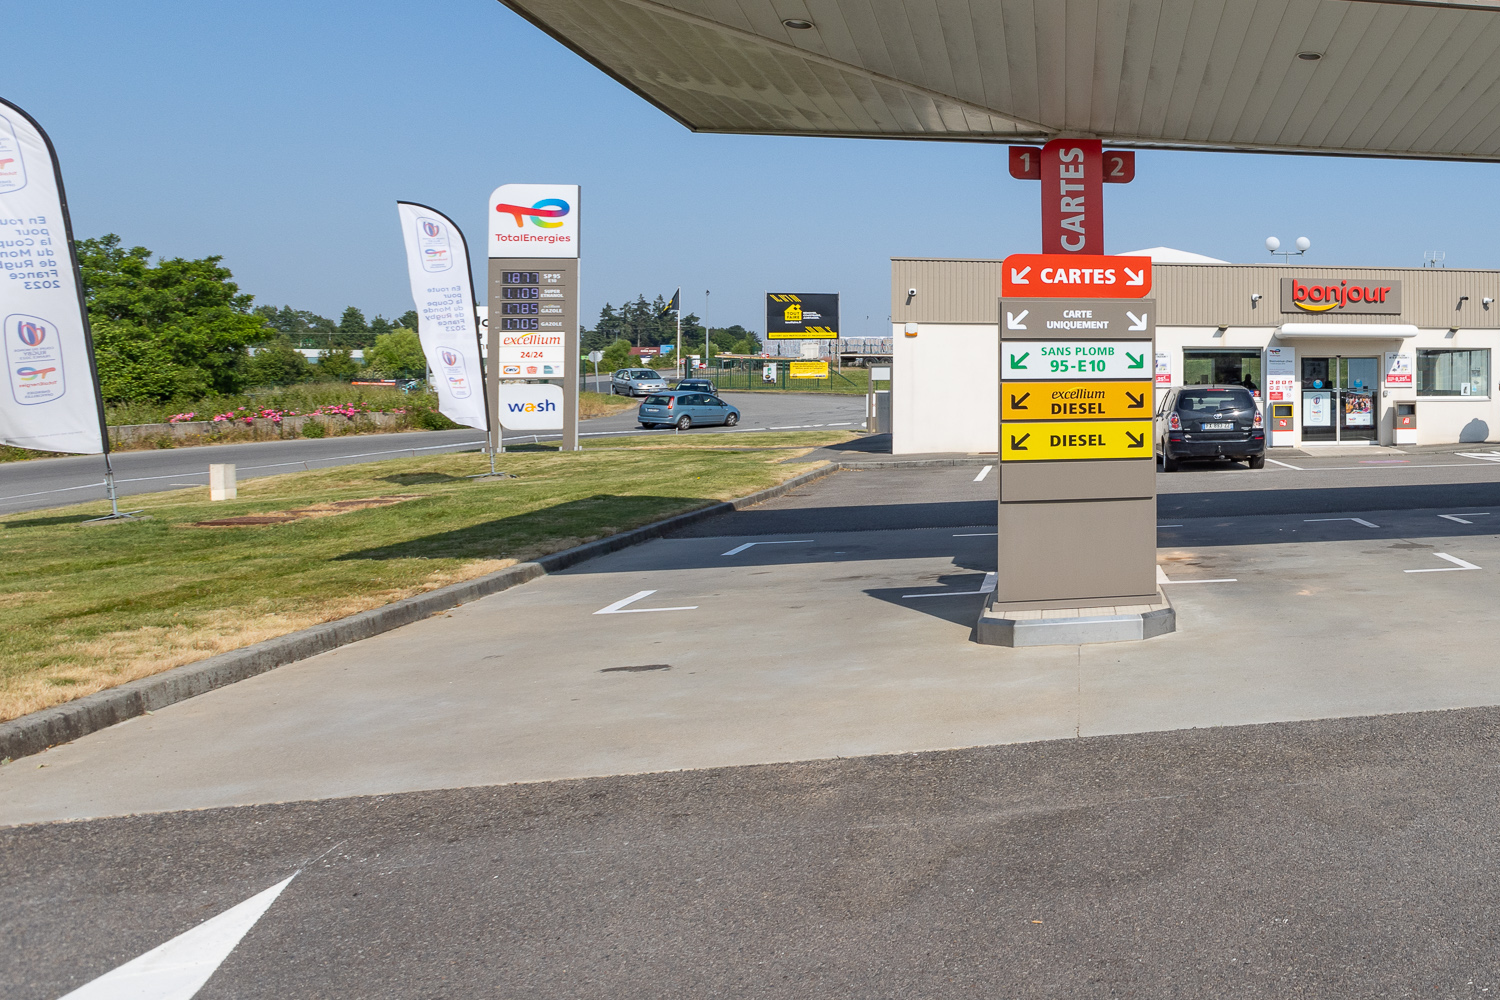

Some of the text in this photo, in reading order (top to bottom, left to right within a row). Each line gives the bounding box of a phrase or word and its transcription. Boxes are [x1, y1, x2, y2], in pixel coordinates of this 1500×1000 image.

[1019, 152, 1030, 172] 1
[1110, 157, 1125, 177] 2
[1059, 147, 1086, 252] CARTES
[495, 233, 571, 244] TotalEnergies
[1040, 267, 1116, 284] CARTES
[1292, 279, 1391, 308] bonjour
[1063, 309, 1092, 318] CARTE
[1046, 320, 1109, 330] UNIQUEMENT
[503, 334, 561, 345] excellium
[1041, 347, 1115, 356] SANS PLOMB
[1050, 360, 1106, 373] 95-E10
[1051, 388, 1105, 400] excellium
[507, 399, 556, 412] wash
[1051, 403, 1105, 415] DIESEL
[1050, 434, 1106, 447] DIESEL
